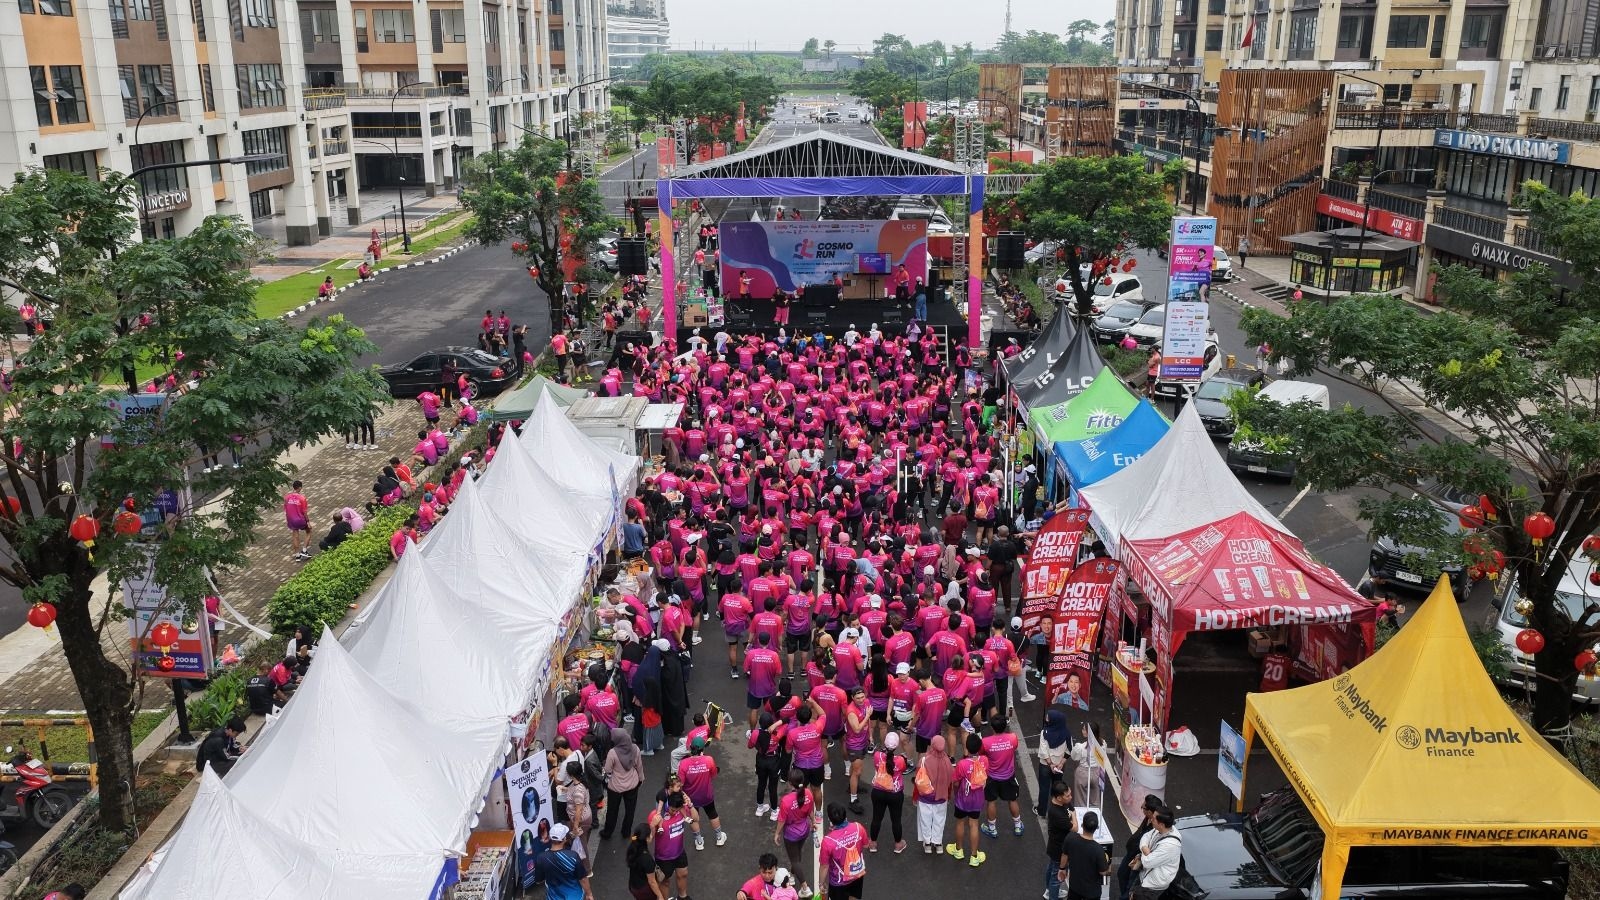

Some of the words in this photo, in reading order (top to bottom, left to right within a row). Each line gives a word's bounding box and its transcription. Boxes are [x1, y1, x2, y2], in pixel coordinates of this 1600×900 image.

[1457, 133, 1489, 151] LIPPO
[1492, 137, 1558, 160] CIKARANG
[815, 251, 835, 259] RUN
[817, 242, 853, 250] COSMO
[1481, 245, 1510, 266] MAXX
[1066, 375, 1094, 390] LC
[1032, 545, 1076, 560] CREAM
[1232, 552, 1275, 564] CREAM
[1143, 568, 1168, 623] CREAM
[1269, 604, 1352, 626] CREAM
[1264, 662, 1283, 681] 20
[1334, 695, 1355, 719] Finance
[1344, 683, 1387, 734] Maybank
[1425, 726, 1522, 747] Maybank
[1427, 746, 1475, 757] Finance
[511, 766, 543, 787] Semangat
[518, 775, 538, 790] Coffee
[1274, 743, 1292, 774] FINANCE
[1291, 771, 1317, 810] CIKARANG
[1383, 829, 1452, 840] MAYBANK
[1456, 829, 1514, 840] FINANCE
[1517, 828, 1588, 839] CIKARANG
